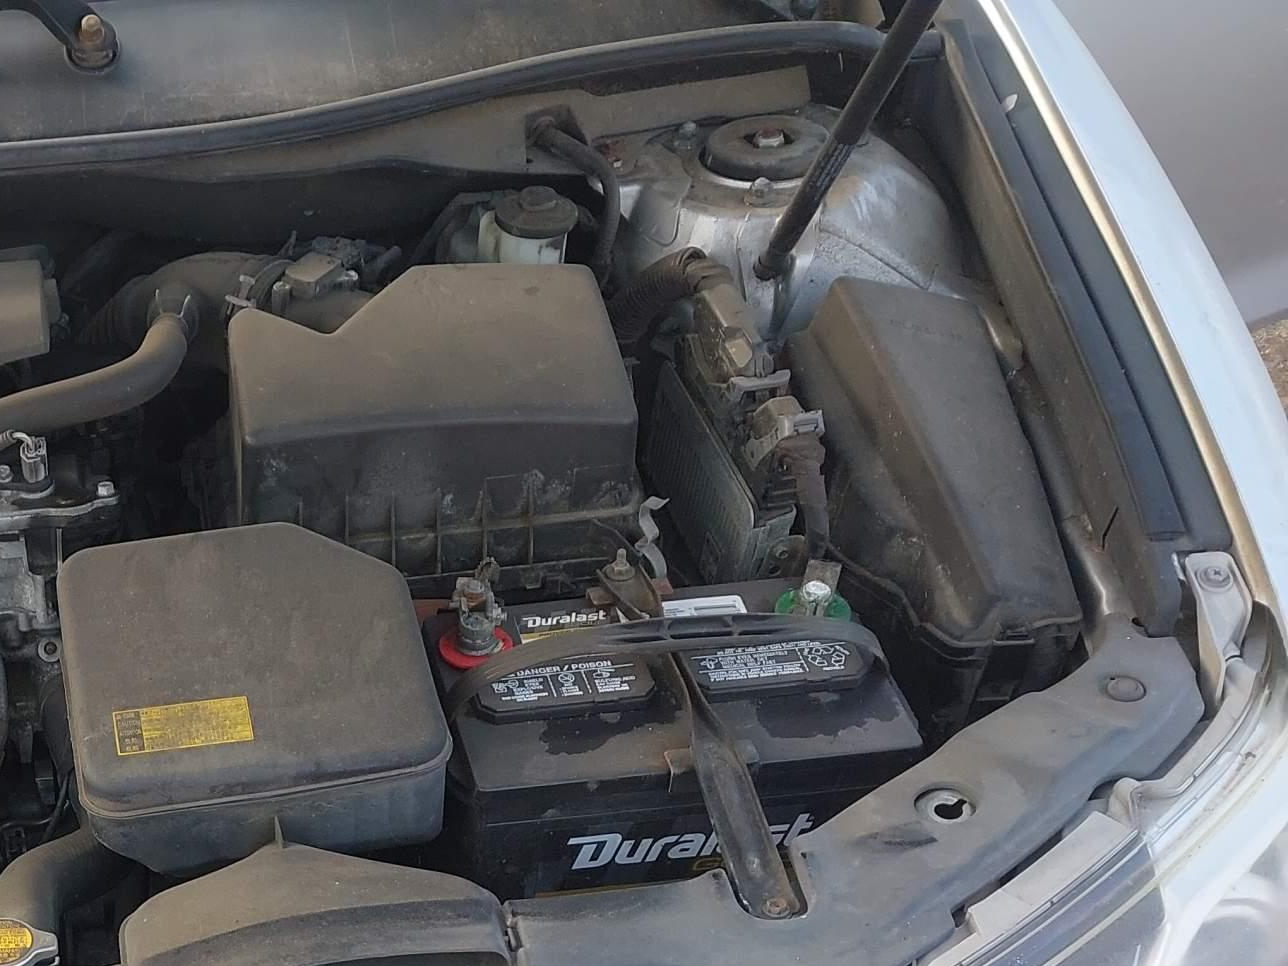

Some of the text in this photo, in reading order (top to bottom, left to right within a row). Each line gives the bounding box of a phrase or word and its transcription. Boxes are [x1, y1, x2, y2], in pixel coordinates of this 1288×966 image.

[522, 610, 606, 628] Duralast
[517, 666, 560, 676] DANGER
[571, 660, 612, 670] POISON
[567, 813, 814, 870] Duralst
